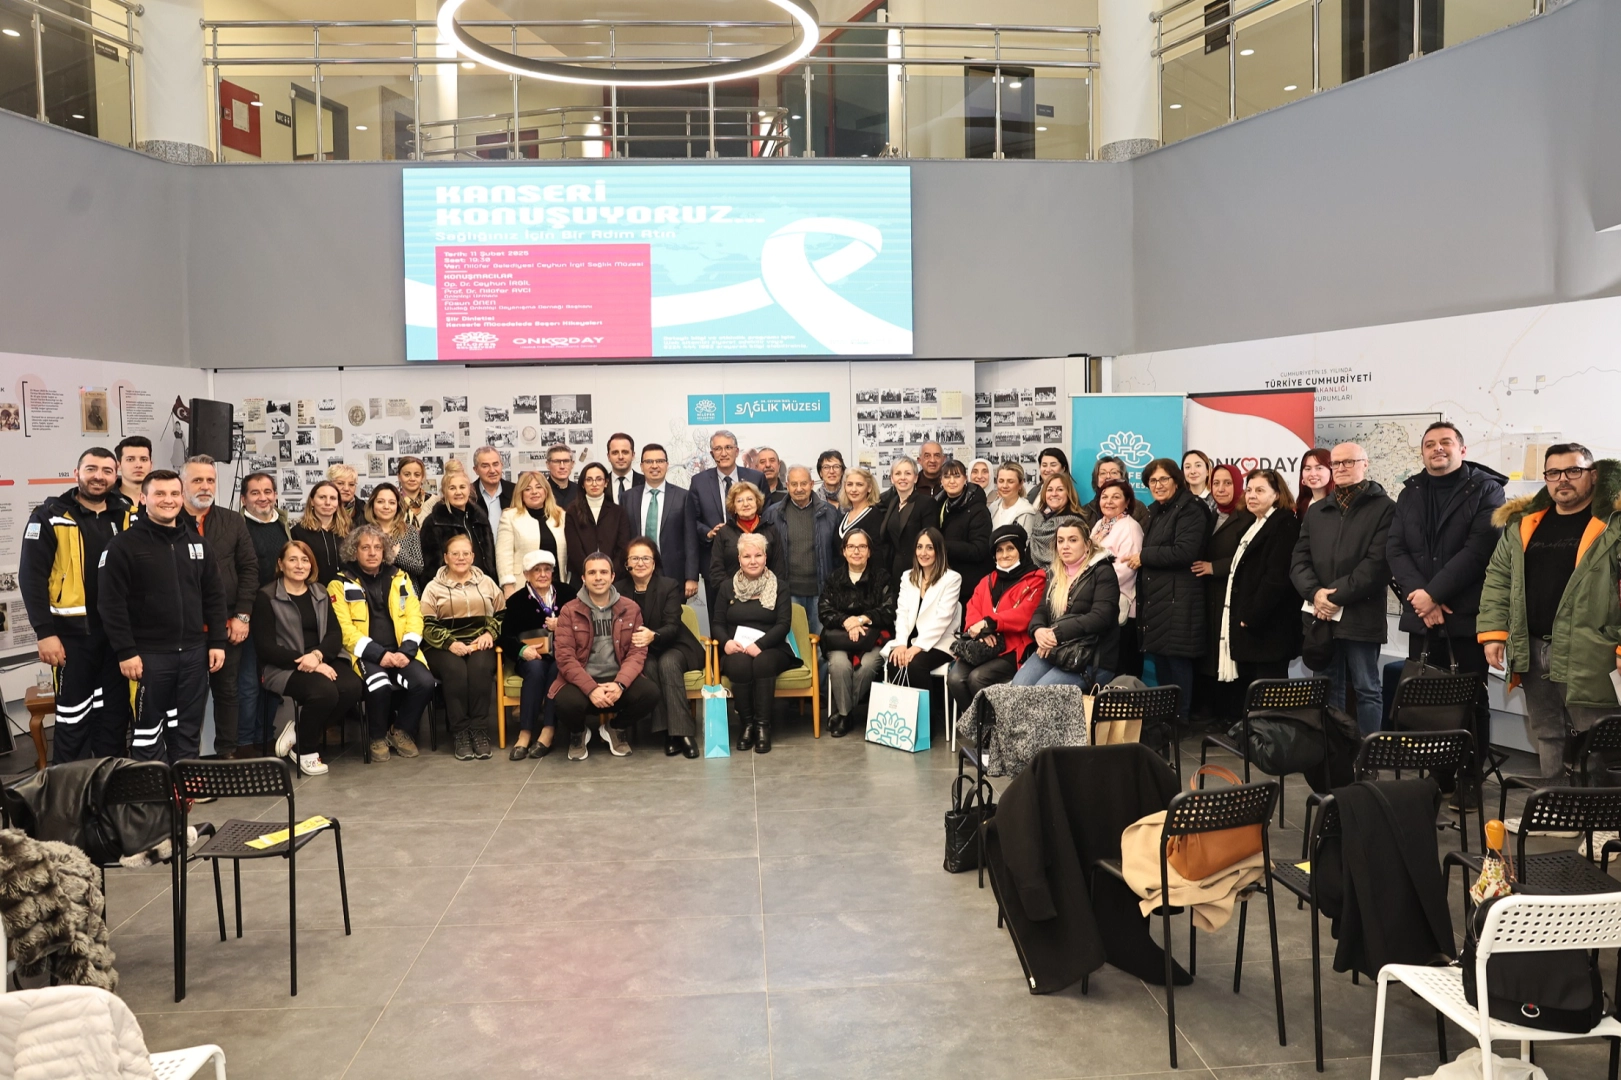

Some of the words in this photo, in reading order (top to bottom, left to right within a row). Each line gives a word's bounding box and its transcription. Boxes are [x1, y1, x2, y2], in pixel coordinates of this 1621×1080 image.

[436, 180, 606, 204] KANSERİ
[436, 205, 766, 229] KONUŞUYORUZ...
[435, 230, 518, 243] Sağlığınız
[524, 229, 555, 242] İçin
[562, 230, 586, 241] Bir
[591, 230, 635, 240] Adım
[641, 228, 677, 239] Atın
[444, 273, 513, 281] KONUŞMACILAR
[473, 280, 506, 288] Ceyhun
[1265, 378, 1302, 388] TÜRKİYE
[1305, 372, 1372, 386] CUMHURİYETİ
[1280, 369, 1320, 379] CUMHURİYETİN
[1315, 385, 1348, 394] AKANLIĞI
[735, 400, 779, 418] SAĞLIK
[782, 399, 821, 412] MÜZESİ
